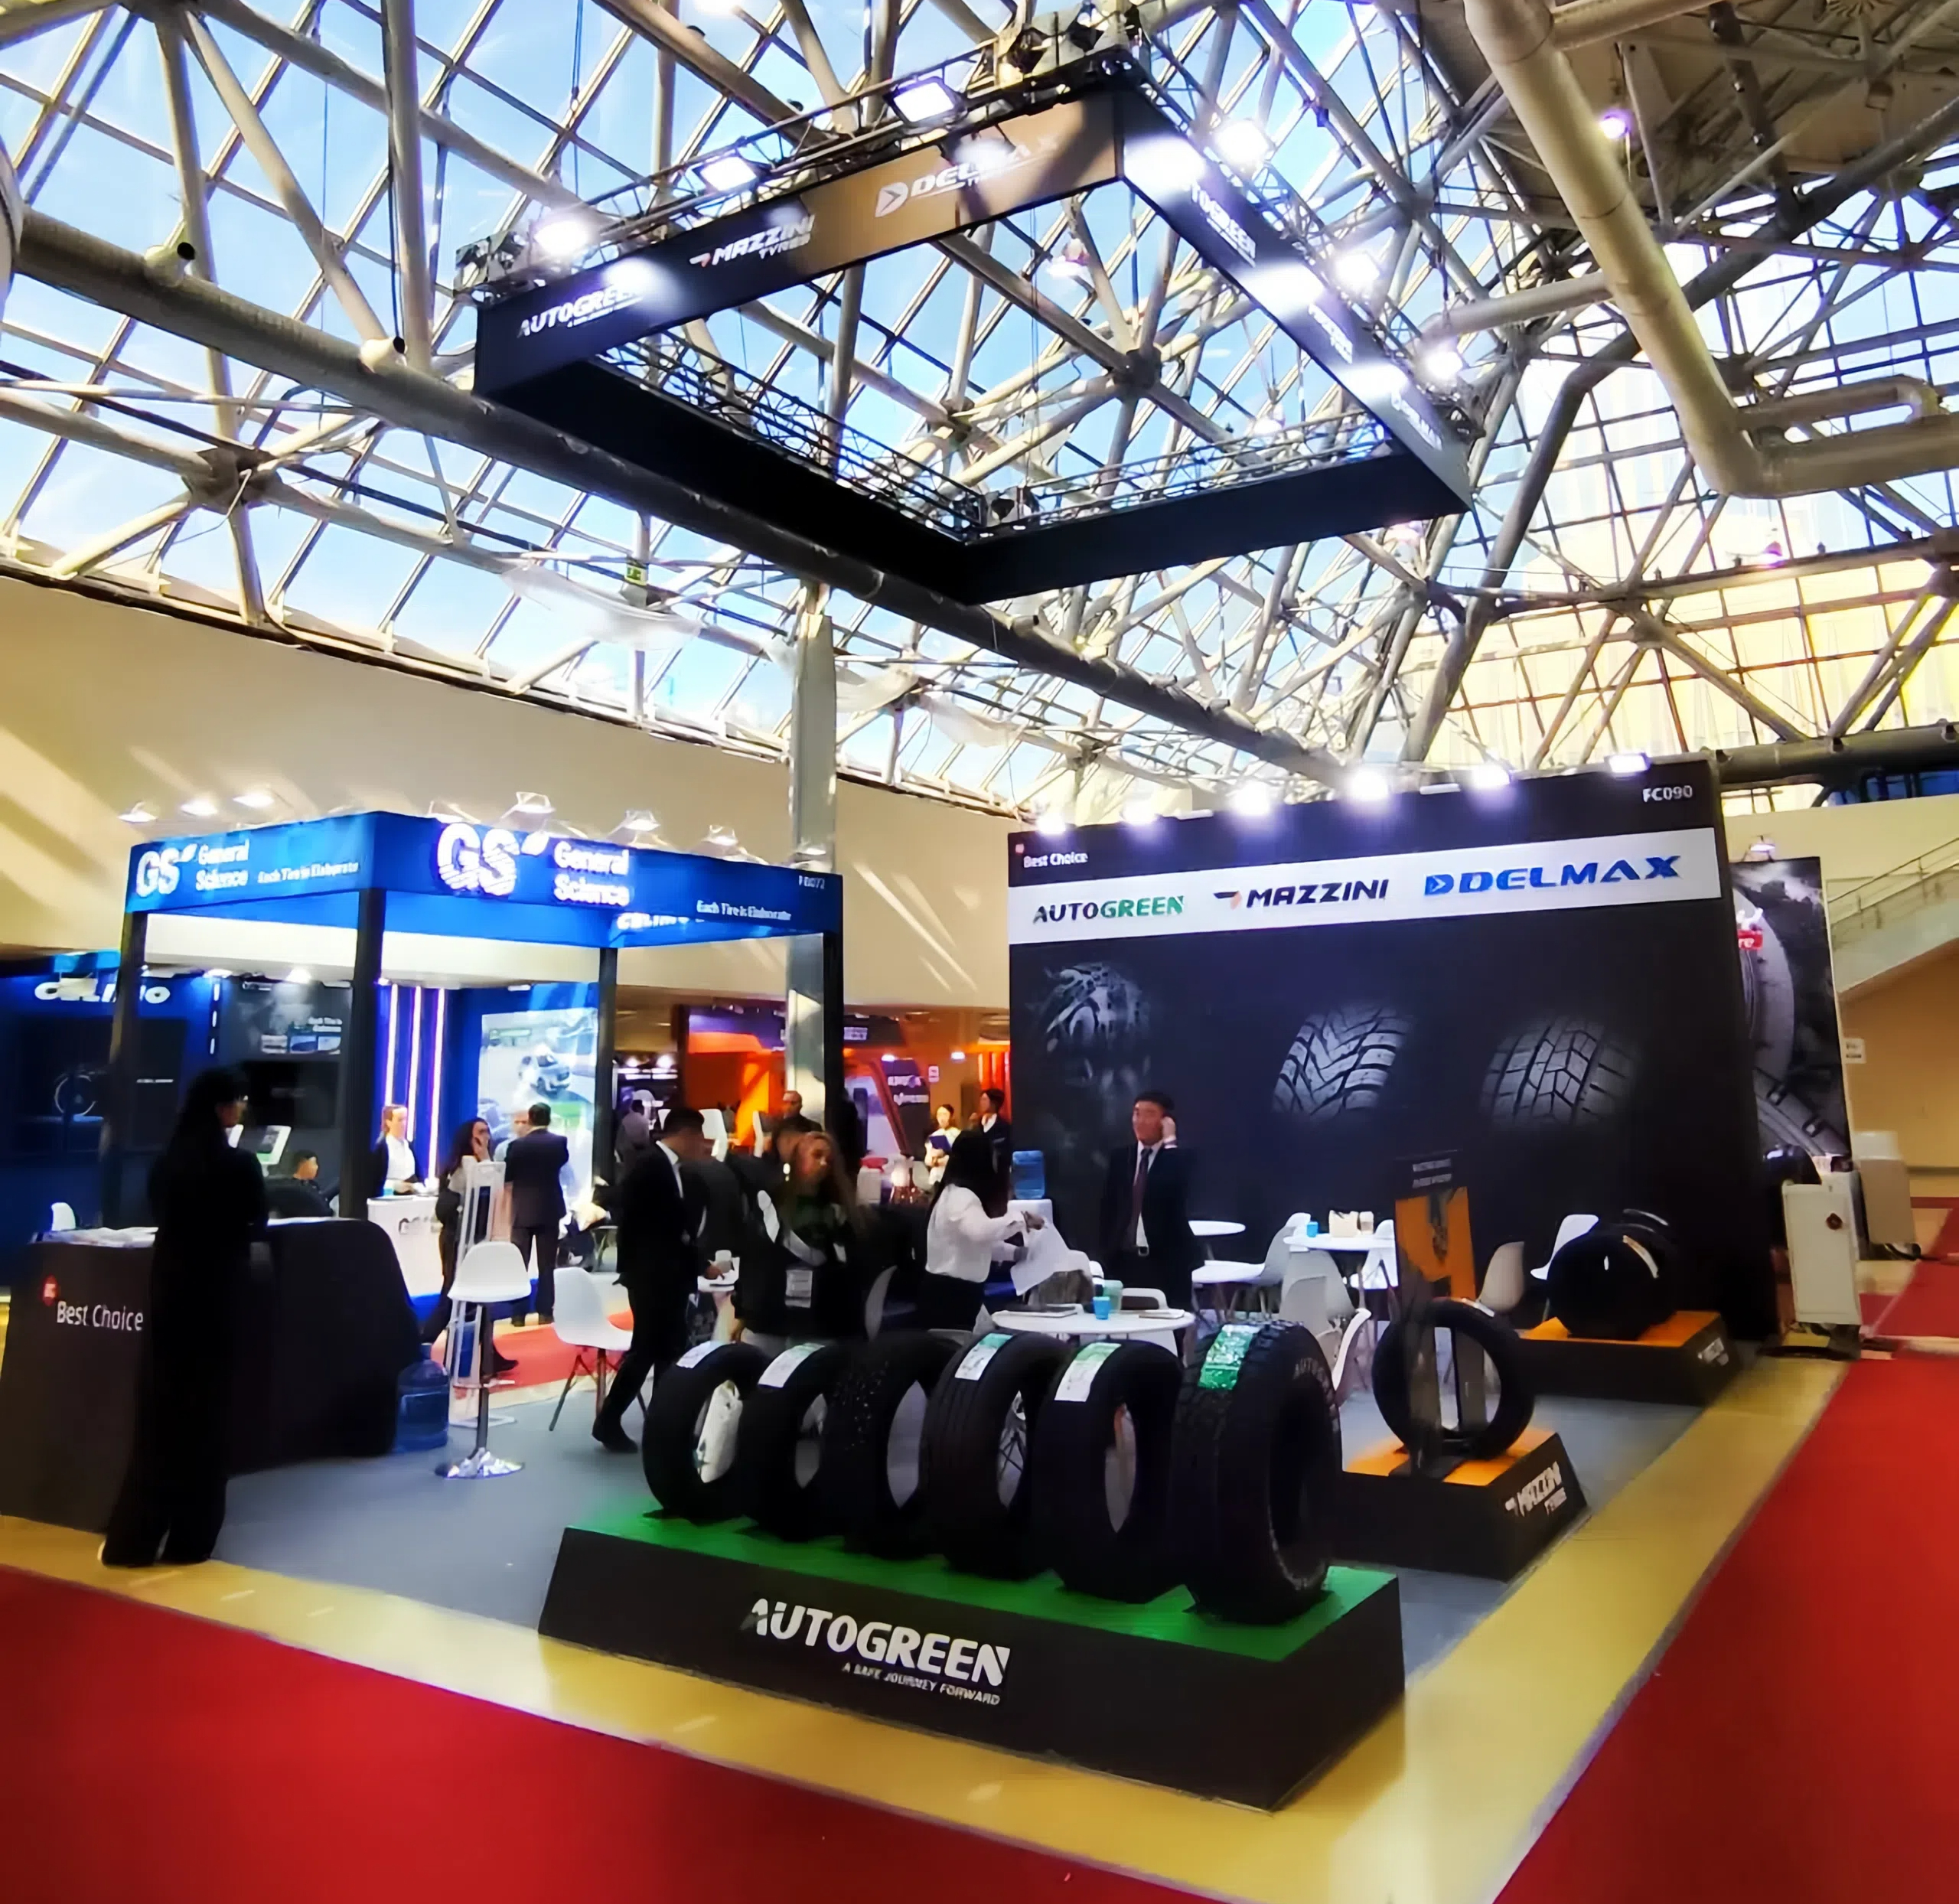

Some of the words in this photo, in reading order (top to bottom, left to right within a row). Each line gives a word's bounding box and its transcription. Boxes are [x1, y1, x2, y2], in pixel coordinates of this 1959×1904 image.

[712, 214, 815, 266] MAZZINI
[1642, 784, 1693, 803] FC090
[136, 847, 180, 898] GS
[198, 838, 250, 866] General
[437, 823, 520, 896] GS
[553, 841, 630, 875] General
[1023, 855, 1048, 869] Best
[1049, 851, 1088, 866] Choice
[553, 873, 631, 907] Science
[1032, 895, 1185, 925] AUTOGREEN
[1246, 879, 1389, 909] MAZZINI
[56, 1300, 90, 1327] Best
[93, 1304, 144, 1331] Choice
[738, 1598, 1011, 1687] AUTOGREEN
[842, 1662, 850, 1673] A
[884, 1671, 937, 1692] JOURNEY
[940, 1683, 1001, 1706] FORWARD
